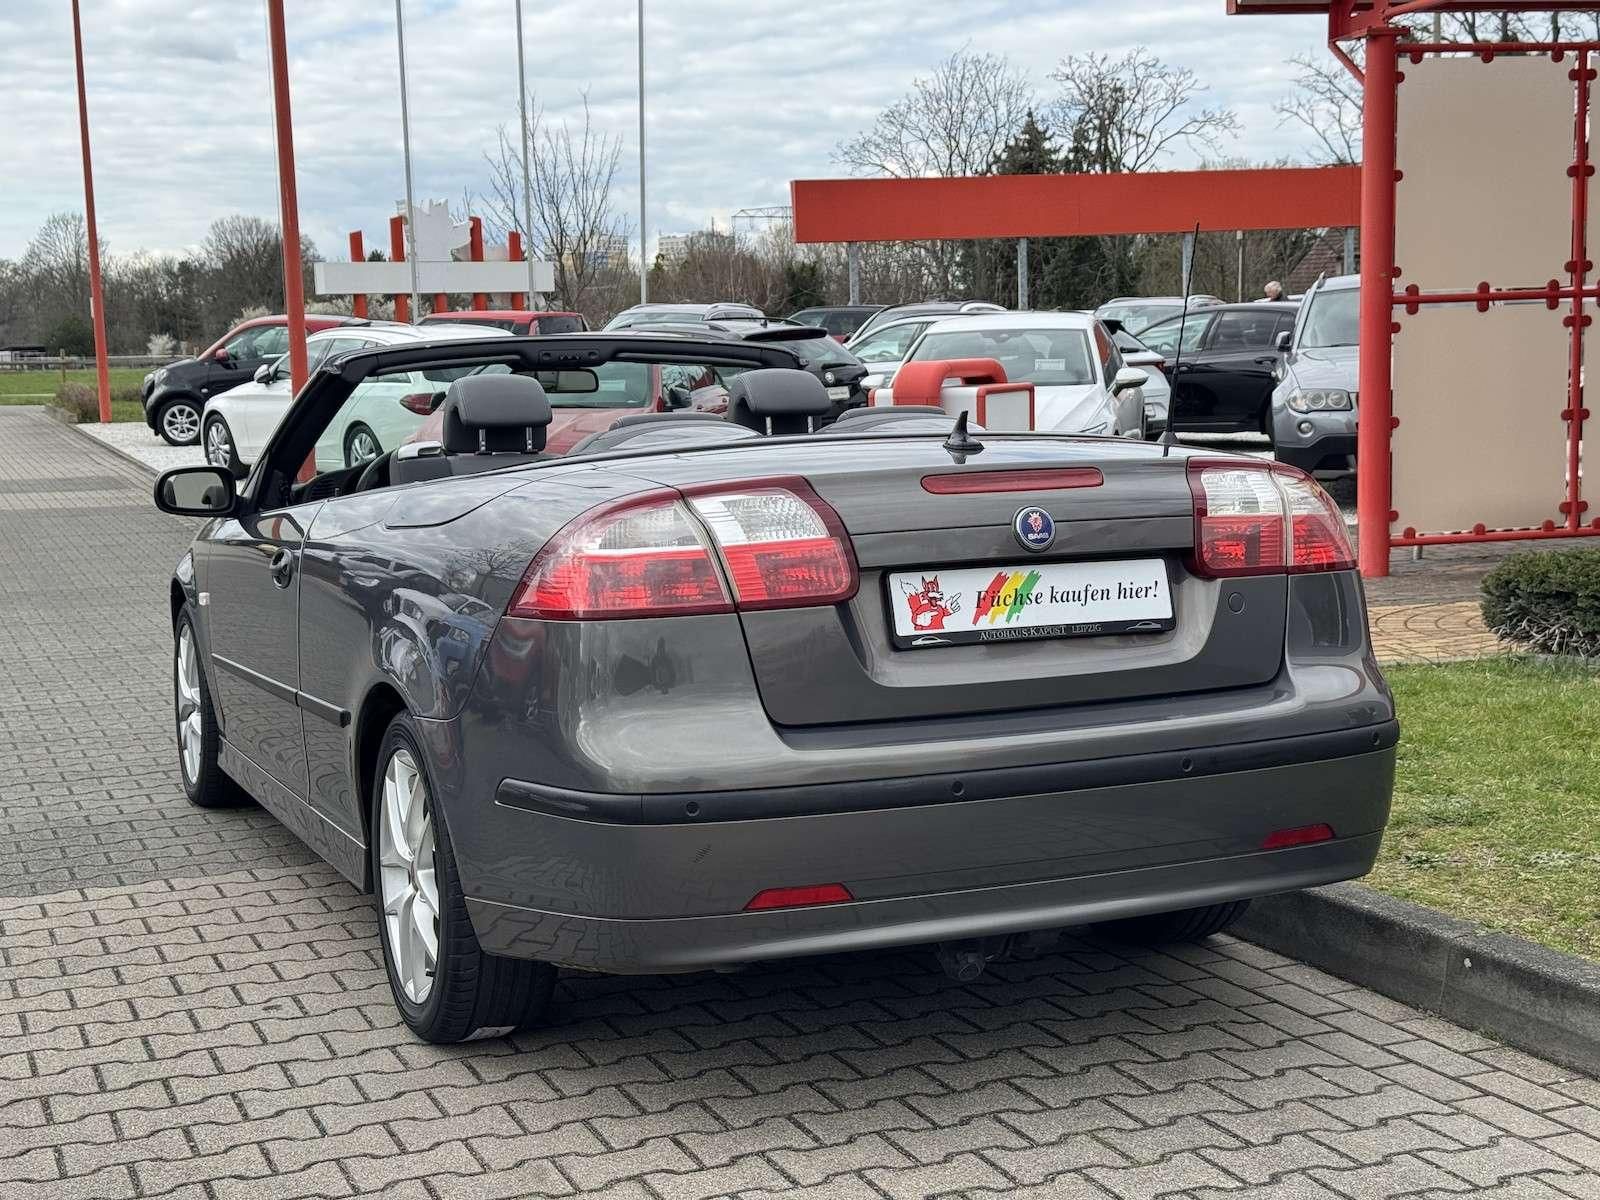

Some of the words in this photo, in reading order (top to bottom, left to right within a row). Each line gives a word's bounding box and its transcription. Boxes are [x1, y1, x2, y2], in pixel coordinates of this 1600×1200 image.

[975, 587, 1043, 609] Füchse
[1050, 583, 1111, 607] kaufen
[1117, 580, 1158, 600] hier!
